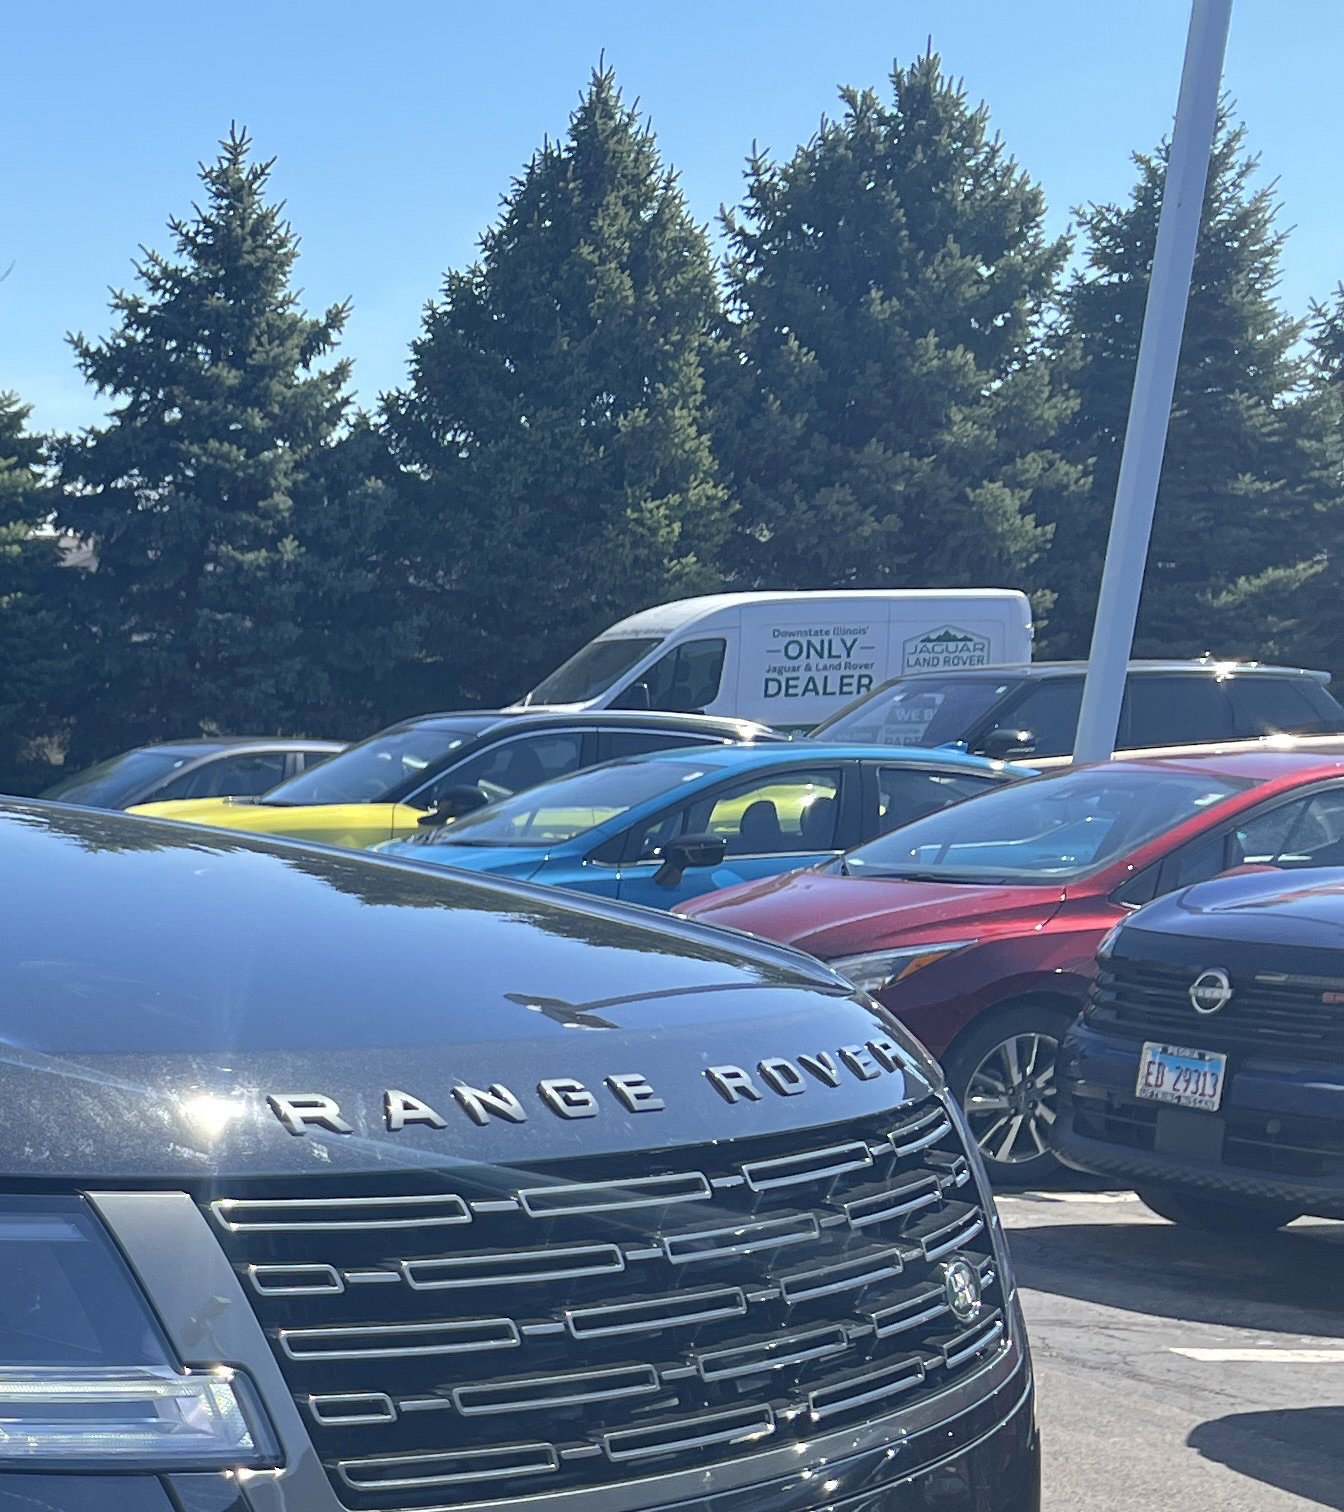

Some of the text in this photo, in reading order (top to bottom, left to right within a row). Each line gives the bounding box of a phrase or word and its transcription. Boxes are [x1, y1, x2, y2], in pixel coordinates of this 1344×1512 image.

[772, 627, 830, 639] Downstate
[783, 637, 858, 661] ONLY
[907, 641, 986, 655] JAGUAR
[765, 660, 875, 676] Jaguar & Land Rover
[906, 655, 985, 668] LAND ROVER
[763, 673, 874, 699] DEALER
[265, 1037, 909, 1137] RANGE ROVER
[1172, 1066, 1219, 1098] 29313
